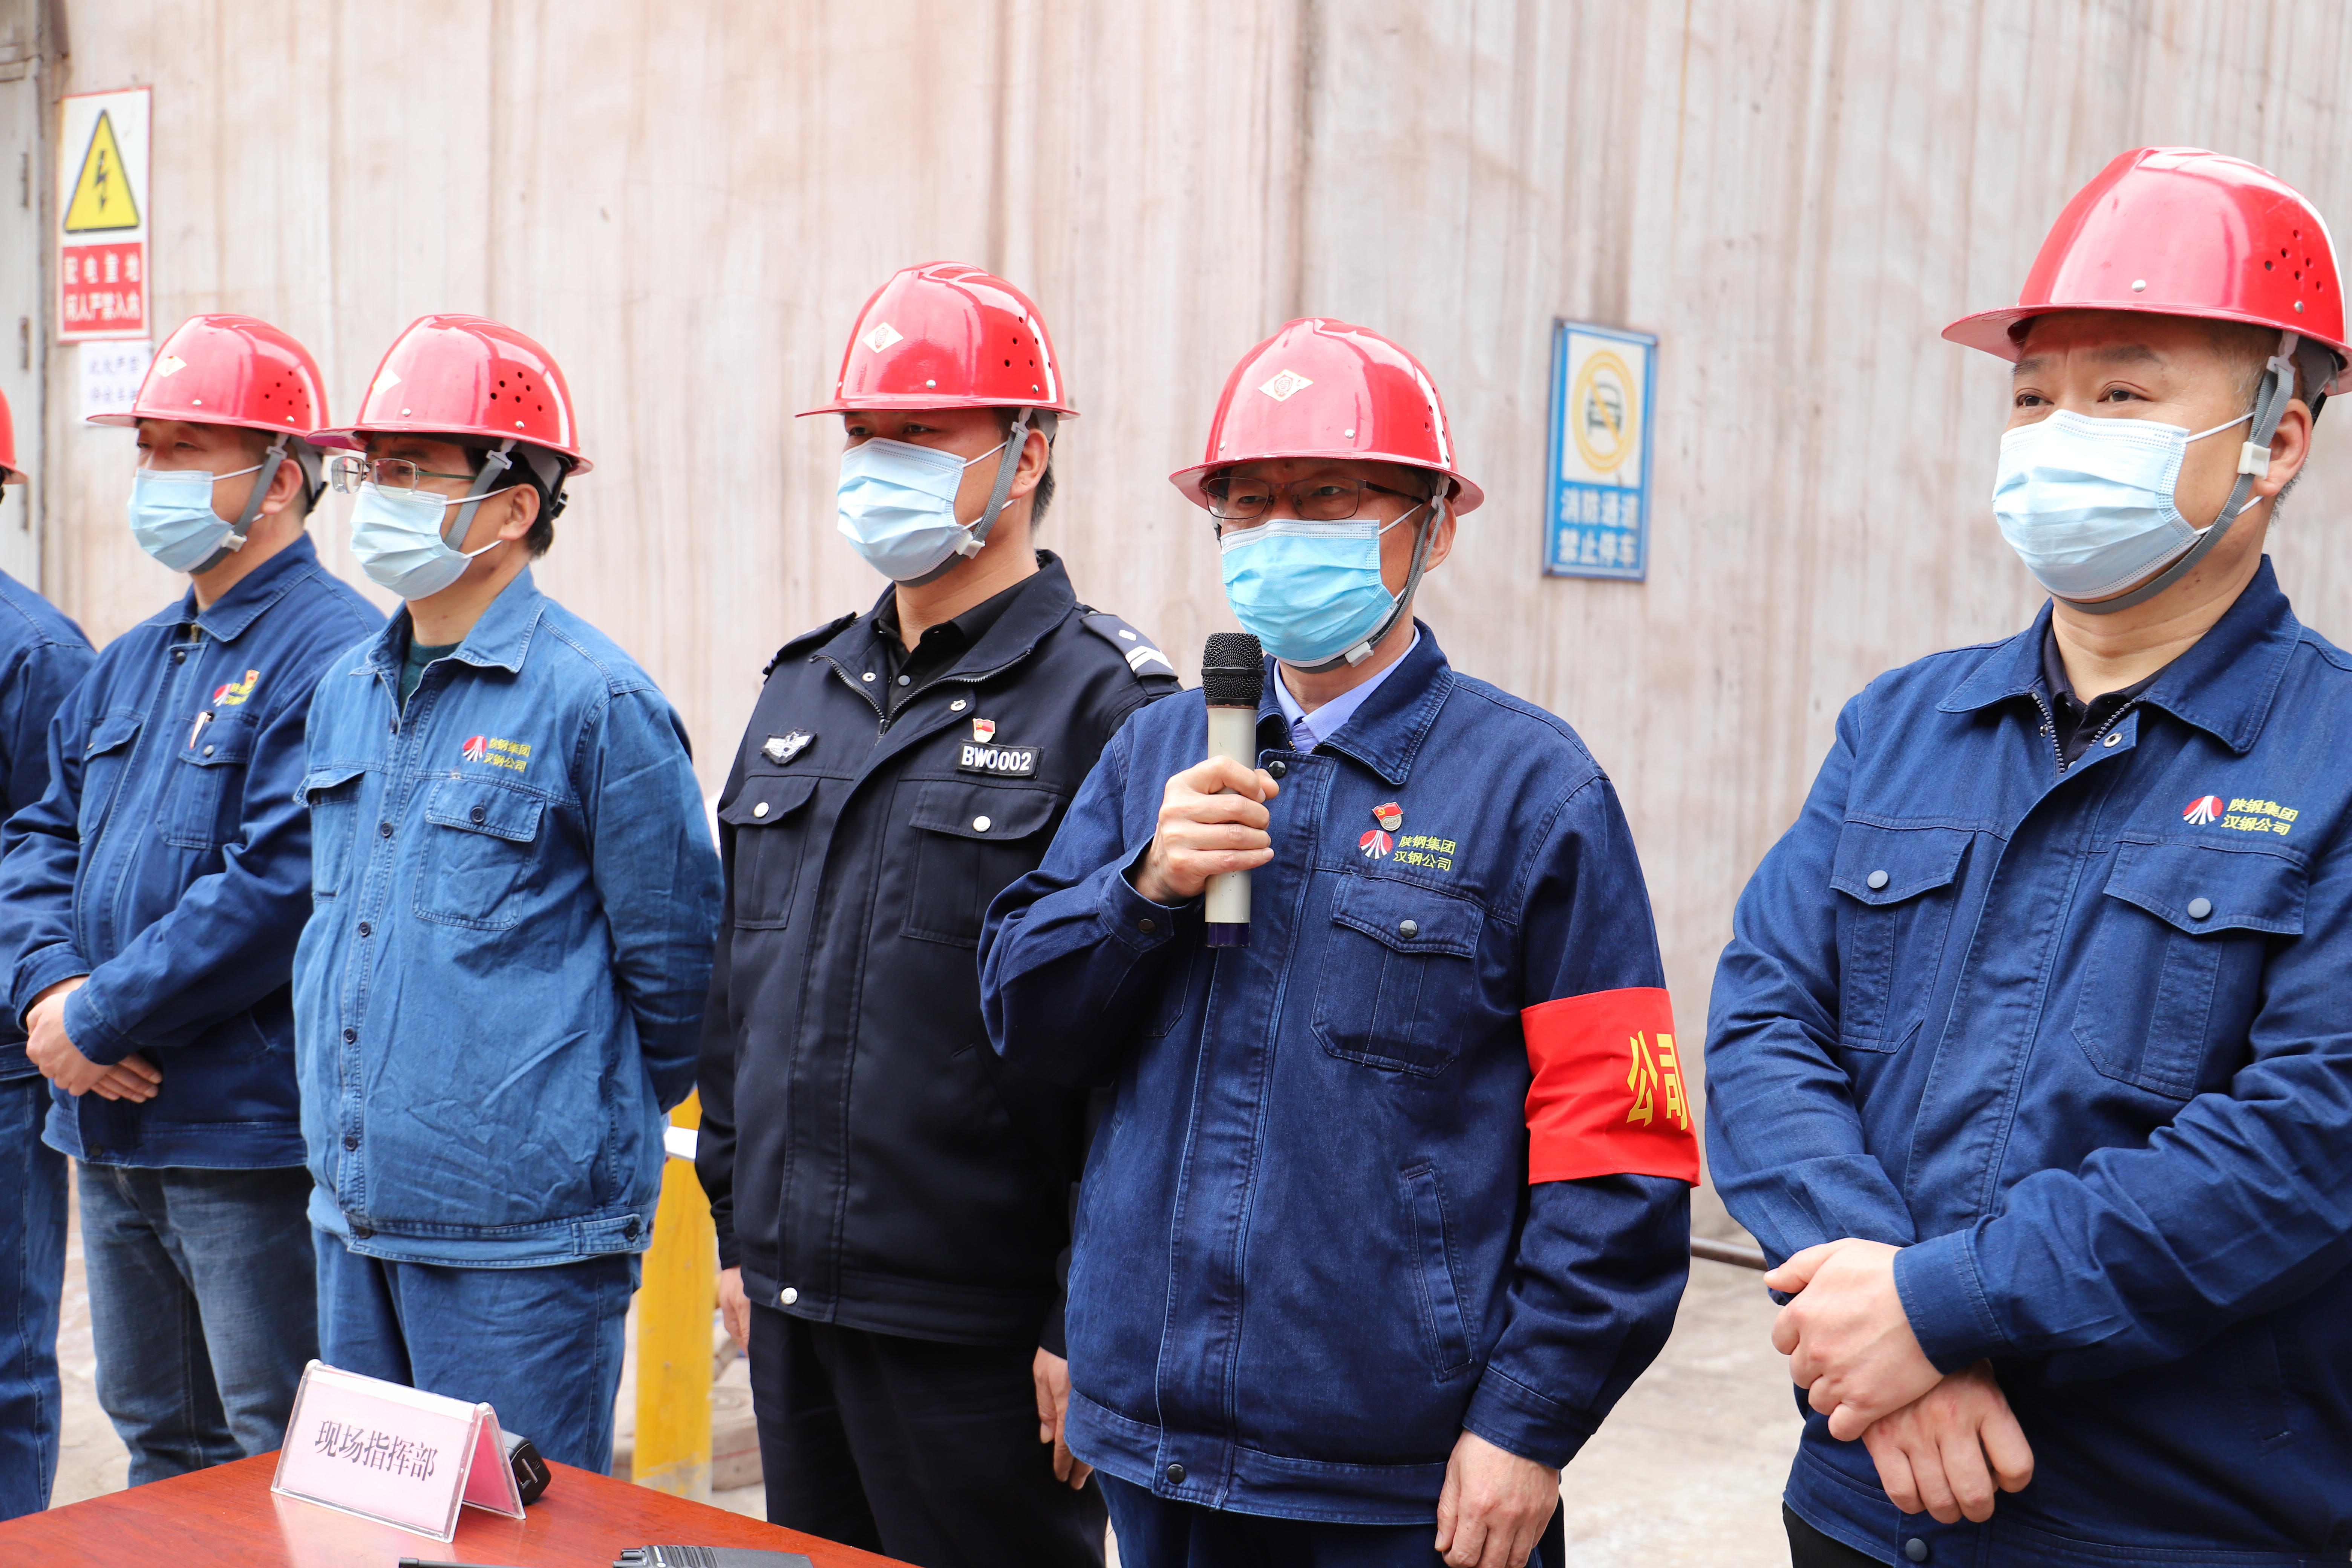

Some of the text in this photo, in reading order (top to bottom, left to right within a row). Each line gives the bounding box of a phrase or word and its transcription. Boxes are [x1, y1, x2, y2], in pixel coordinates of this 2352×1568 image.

[64, 250, 141, 284] 配电重地
[1560, 487, 1639, 529] 消防通道
[1558, 528, 1637, 567] 禁止停车
[962, 746, 1032, 771] BW0002
[2220, 814, 2291, 835] 汉钢公司
[2227, 798, 2298, 822] 陕钢集团
[1398, 835, 1456, 855] 陕钢集团
[1393, 851, 1452, 871] 汉钢公司
[1626, 1031, 1692, 1131] 公司
[315, 1420, 438, 1481] 现场指挥部
